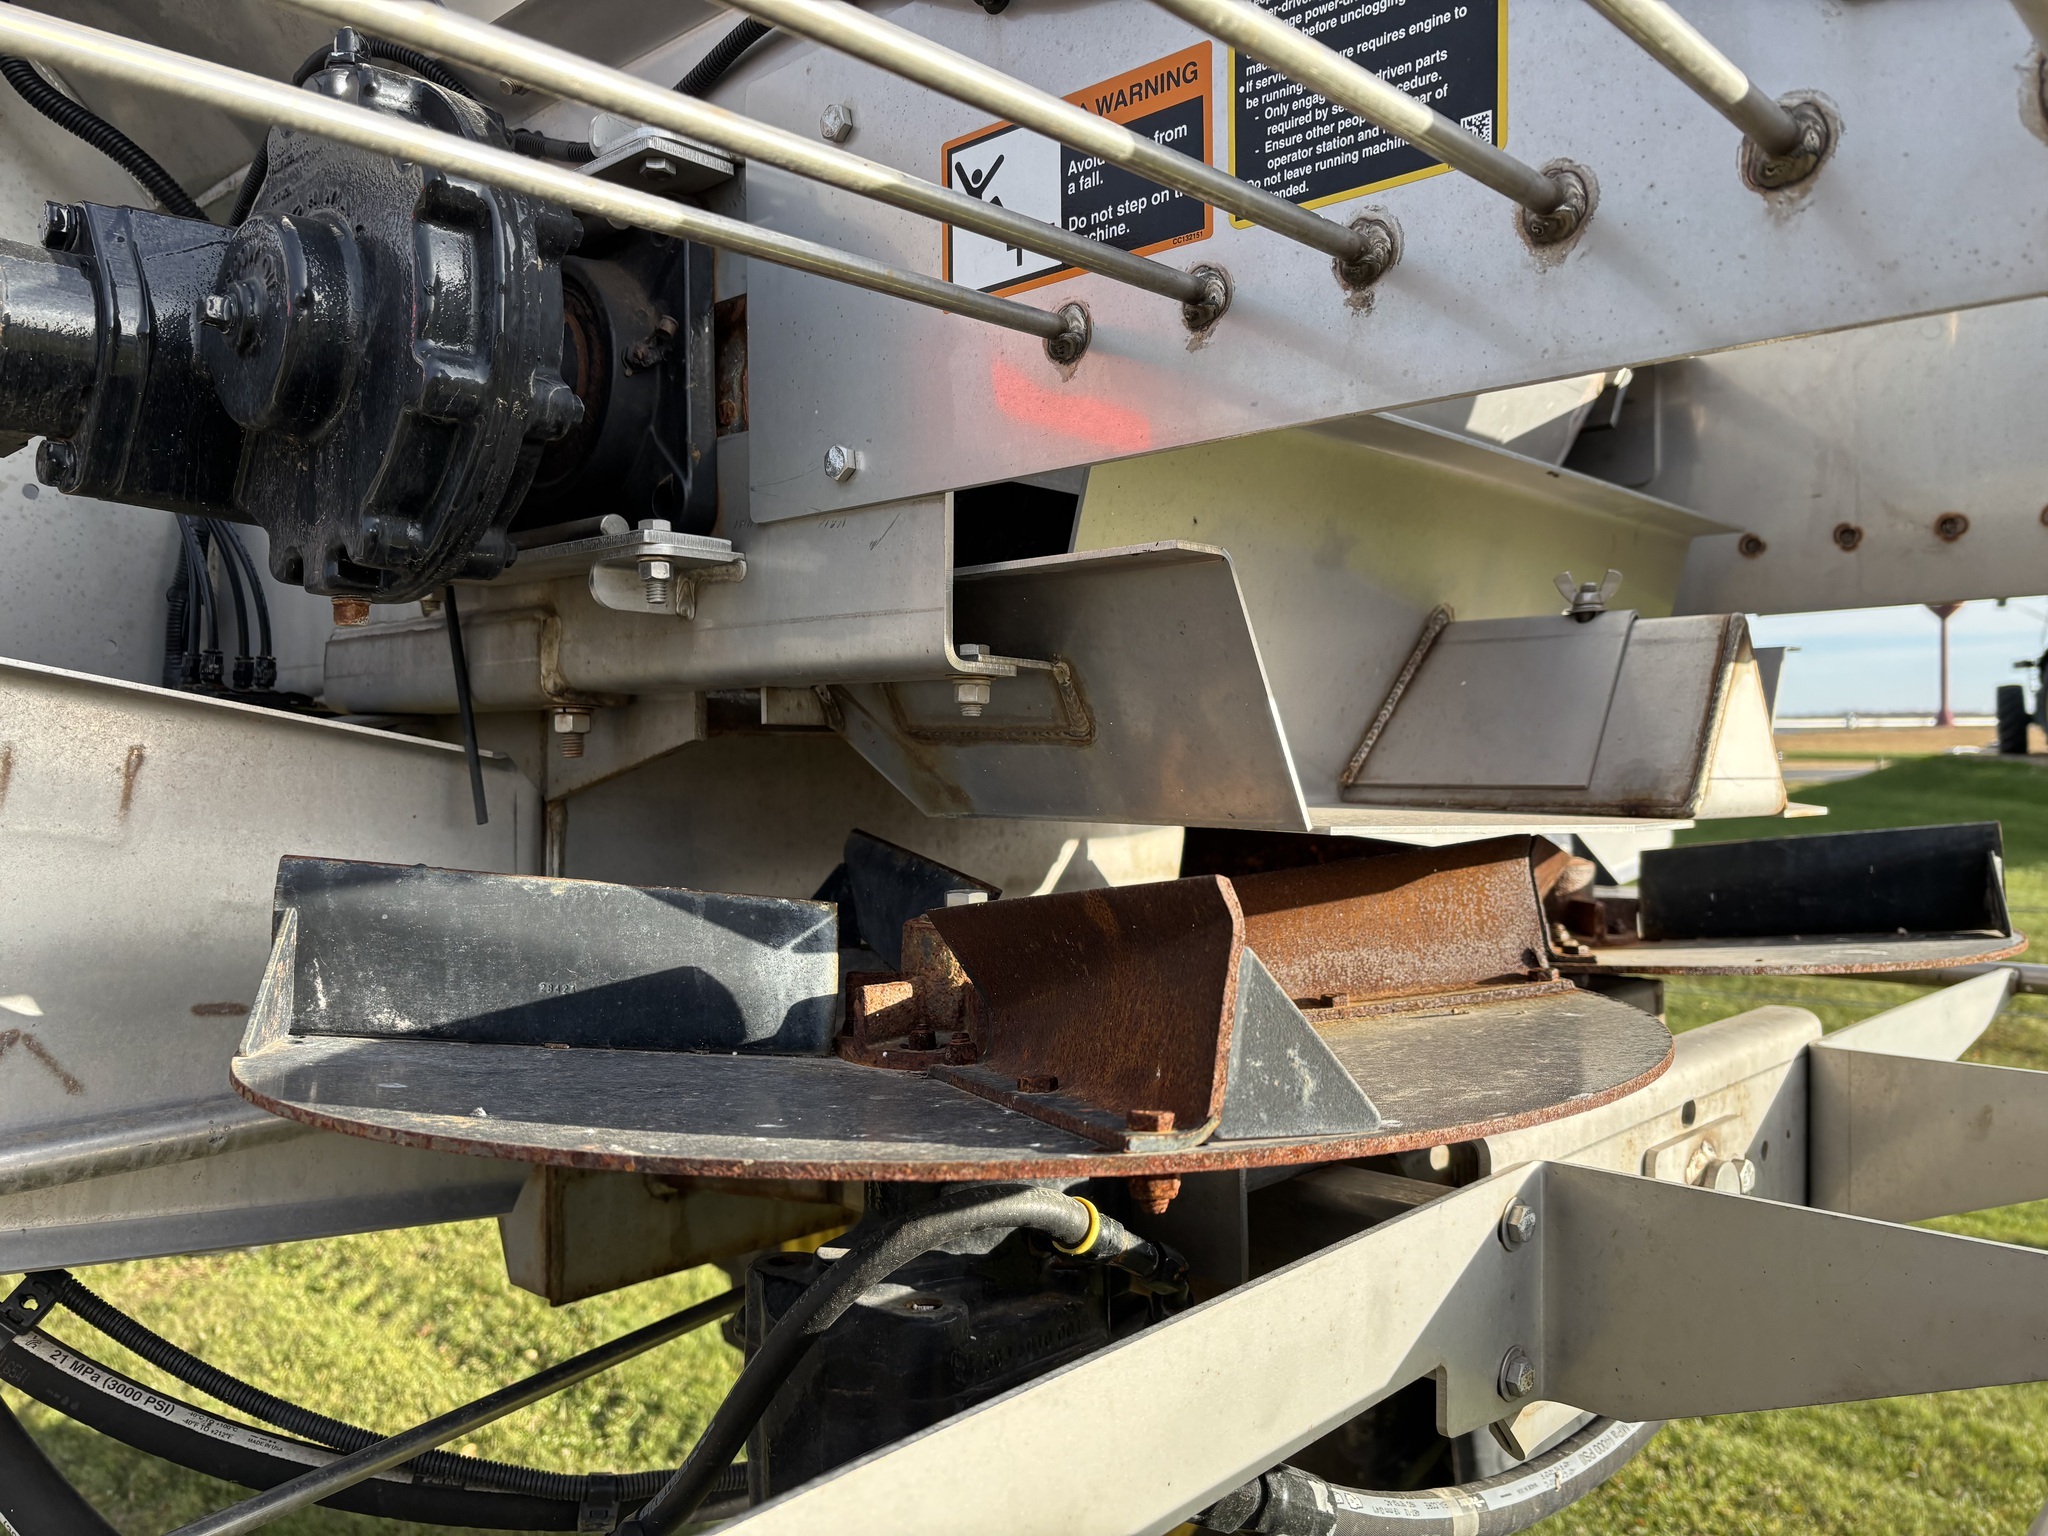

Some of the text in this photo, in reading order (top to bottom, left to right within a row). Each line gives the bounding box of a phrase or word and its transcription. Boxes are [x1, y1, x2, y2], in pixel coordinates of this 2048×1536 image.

[1302, 18, 1338, 37] before
[1357, 28, 1406, 54] requires
[1409, 10, 1451, 36] engine
[1454, 5, 1468, 20] to
[1095, 61, 1198, 116] WARNING
[1246, 83, 1307, 110] be running.
[1255, 72, 1288, 90] servic
[1264, 103, 1290, 120] Only
[1292, 93, 1326, 111] engag
[1415, 49, 1448, 73] parts
[1154, 124, 1188, 145] from
[1264, 132, 1303, 154] Ensure
[1306, 121, 1335, 141] other
[1435, 83, 1449, 100] of
[1267, 110, 1312, 136] required
[1315, 107, 1329, 122] by
[1267, 125, 1379, 170] operator station and
[1068, 171, 1104, 195] a fall.
[1264, 172, 1281, 187] not
[1284, 164, 1312, 181] leave
[1315, 150, 1359, 172] running
[1068, 216, 1087, 232] Do
[1091, 205, 1113, 225] not
[1116, 196, 1147, 217] step
[1151, 189, 1170, 206] on
[1172, 231, 1204, 245] CC132151
[50, 1349, 175, 1417] 21 MPa (3000 PSI)
[247, 1437, 264, 1447] MADE
